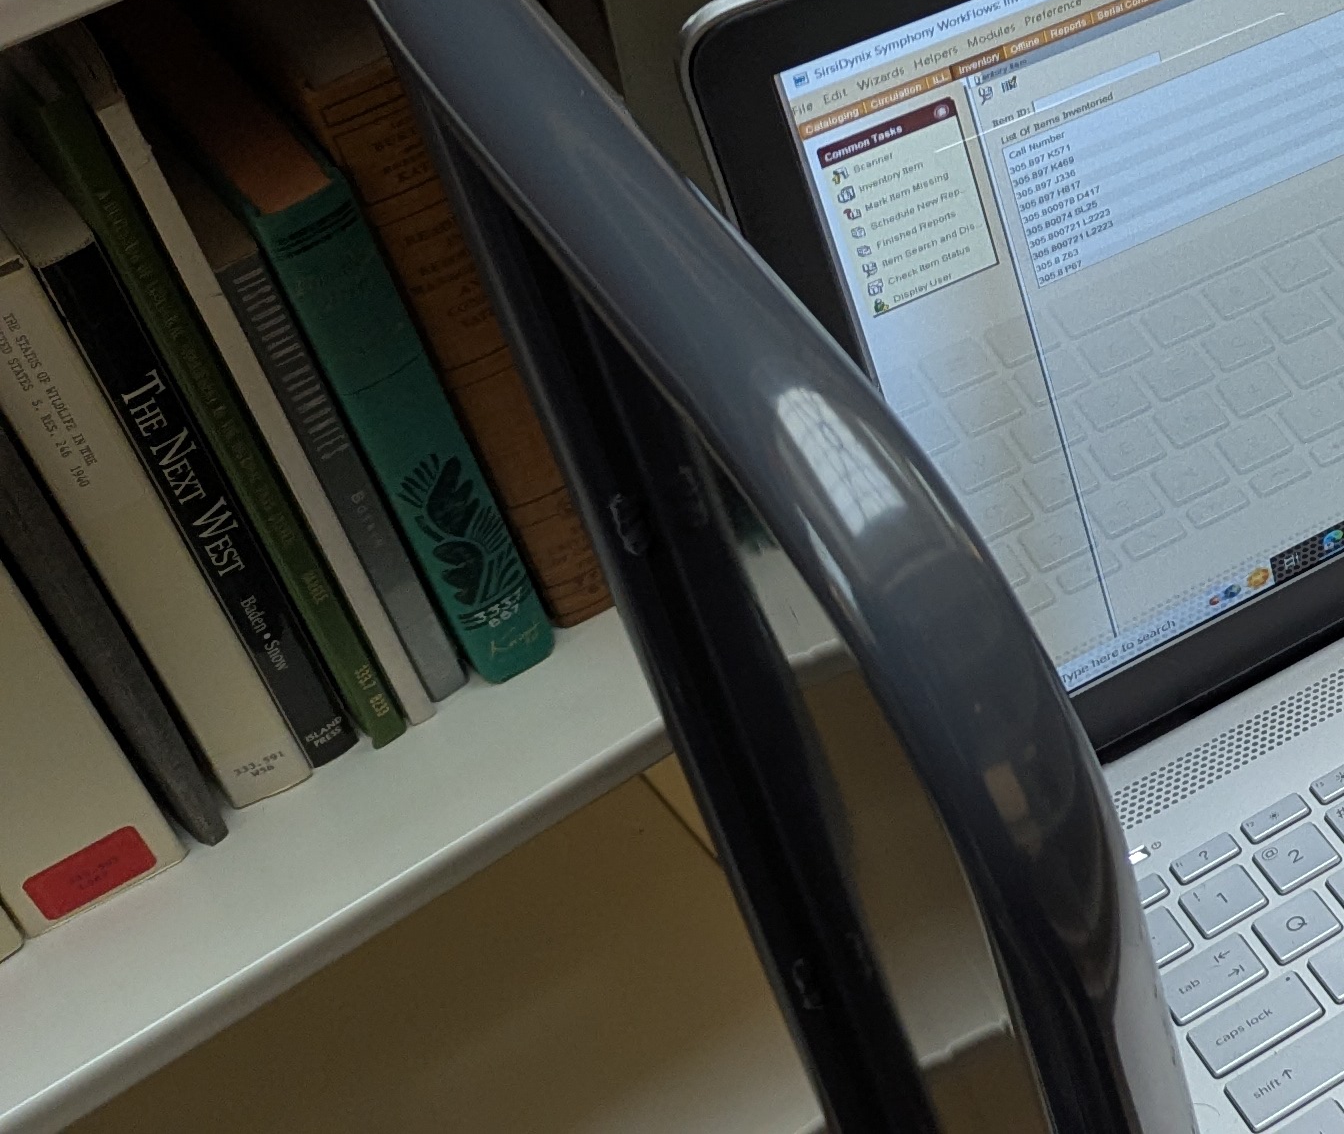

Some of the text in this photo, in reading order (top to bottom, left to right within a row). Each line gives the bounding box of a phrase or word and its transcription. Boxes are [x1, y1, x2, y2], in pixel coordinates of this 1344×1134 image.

[814, 50, 872, 80] SirsiDynix
[874, 26, 935, 57] Symphony
[936, 1, 1001, 32] WorkFlows:
[1049, 17, 1087, 40] Reports
[792, 101, 813, 116] File
[823, 88, 848, 105] Edit
[856, 66, 905, 91] Wizards
[913, 45, 959, 71] Helpers
[967, 23, 1016, 49] Modules
[958, 50, 1000, 75] Inventory
[824, 125, 903, 163] Common Tasks
[1008, 131, 1065, 160] Call Number
[15, 332, 39, 370] STATUS
[37, 368, 50, 383] OF
[45, 379, 77, 433] WILDLIFE
[68, 461, 90, 488] 1940
[121, 368, 246, 578] THE NEXT WEST
[240, 595, 289, 672] Baden Snow
[305, 715, 342, 743] ISLAND
[313, 726, 342, 748] PRESS
